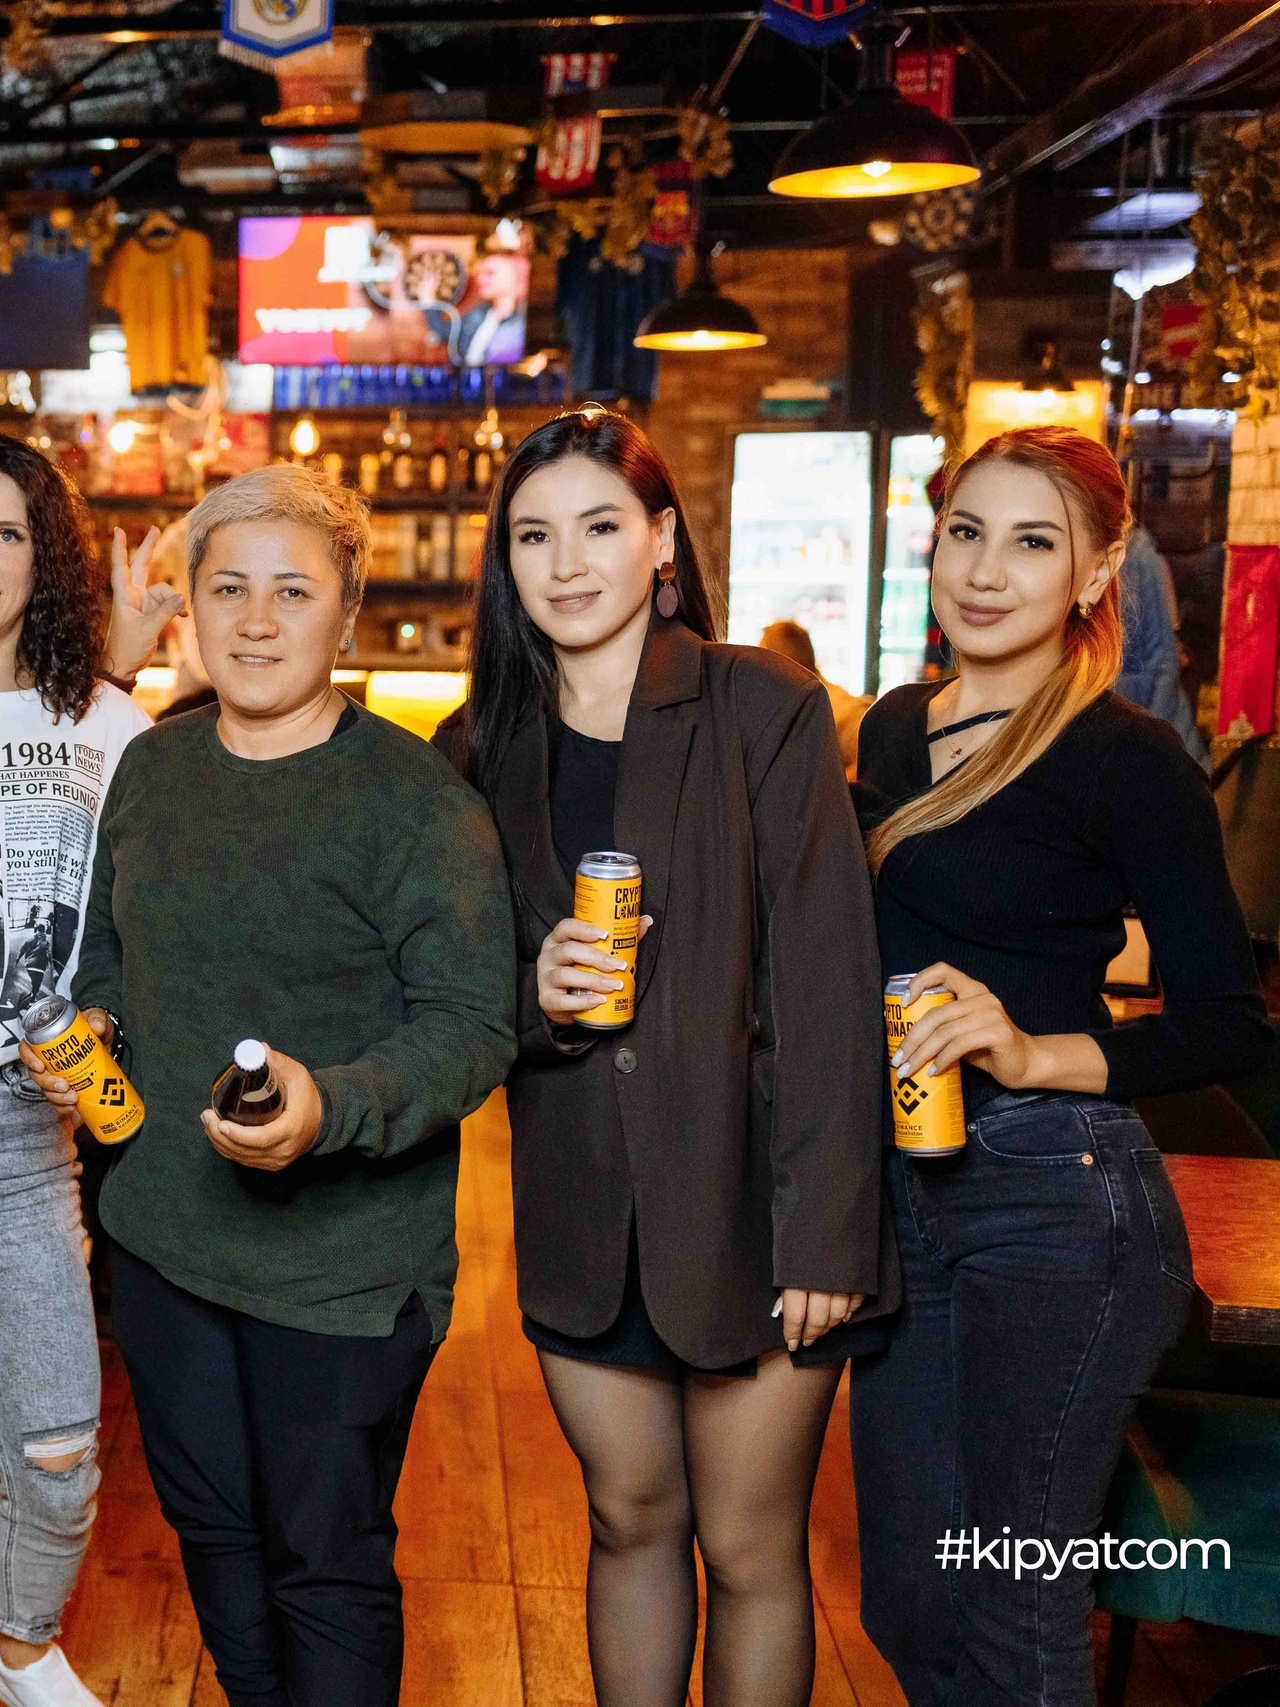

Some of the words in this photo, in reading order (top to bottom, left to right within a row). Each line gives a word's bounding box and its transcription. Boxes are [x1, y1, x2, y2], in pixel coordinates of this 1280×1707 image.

[2, 742, 71, 768] 1984
[77, 756, 101, 772] NEWS
[19, 770, 70, 779] HAPPENES
[26, 782, 47, 794] OF
[6, 849, 24, 859] Do
[28, 849, 57, 860] your
[7, 860, 30, 871] you
[34, 857, 57, 868] still
[41, 1034, 80, 1061] CRYPTO
